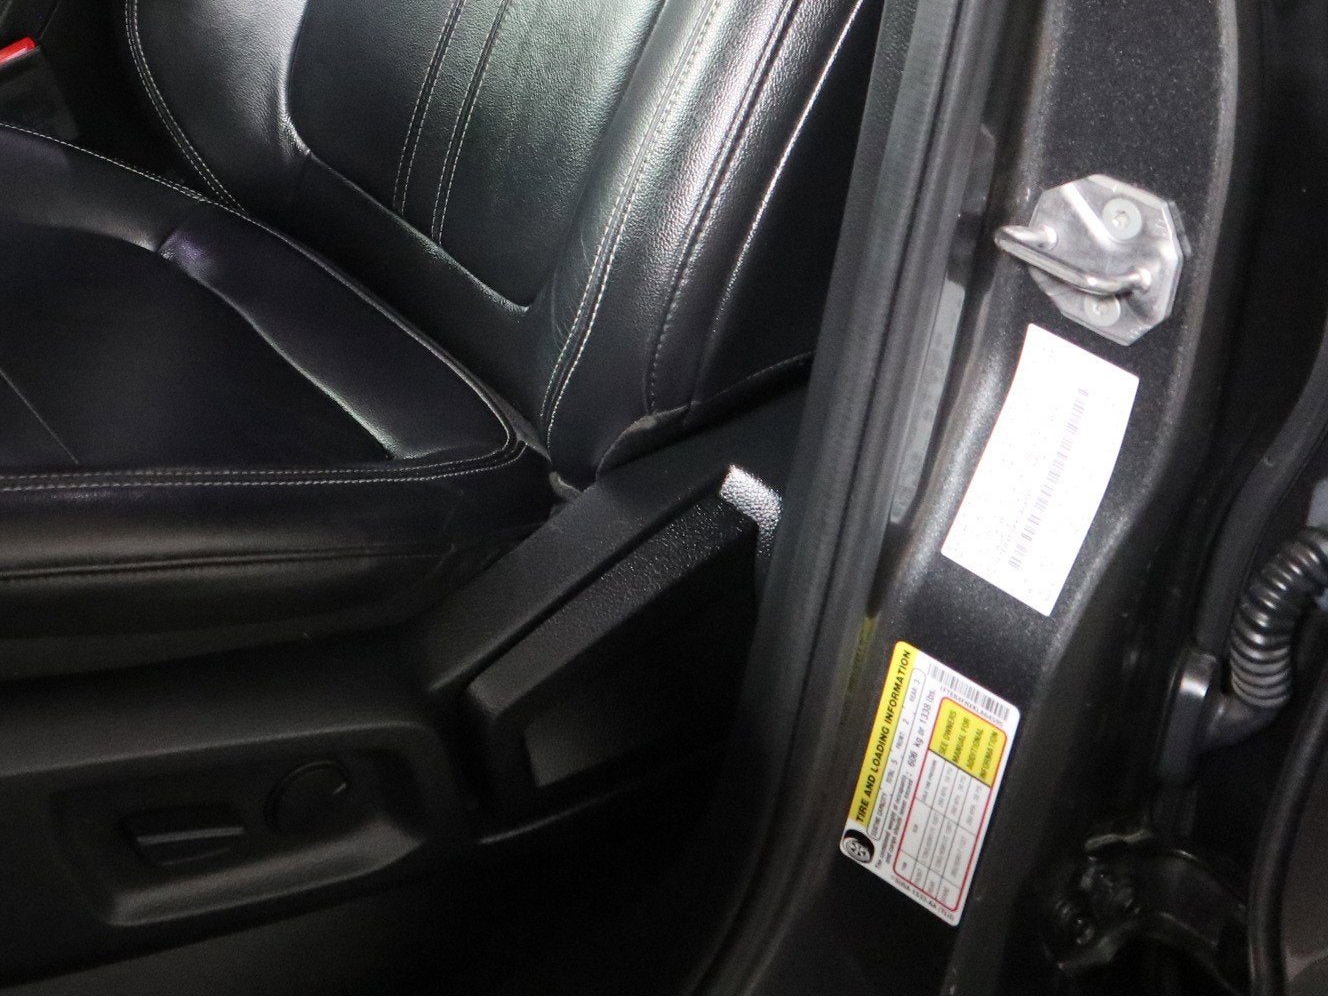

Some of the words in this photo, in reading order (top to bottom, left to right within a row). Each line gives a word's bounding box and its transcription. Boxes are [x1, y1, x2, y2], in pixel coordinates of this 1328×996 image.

[919, 702, 931, 725] 1338
[856, 798, 869, 824] TIRE
[863, 773, 875, 797] AND
[870, 725, 889, 773] LOADING
[884, 648, 911, 724] INFORMATION
[913, 736, 923, 749] kg
[917, 726, 925, 736] or
[952, 733, 966, 763] MANUAL
[961, 716, 970, 733] FOR
[938, 739, 948, 755] SEE
[966, 727, 983, 770] ADDITIONAL
[978, 730, 998, 780] INFORMATION
[907, 750, 918, 768] 606
